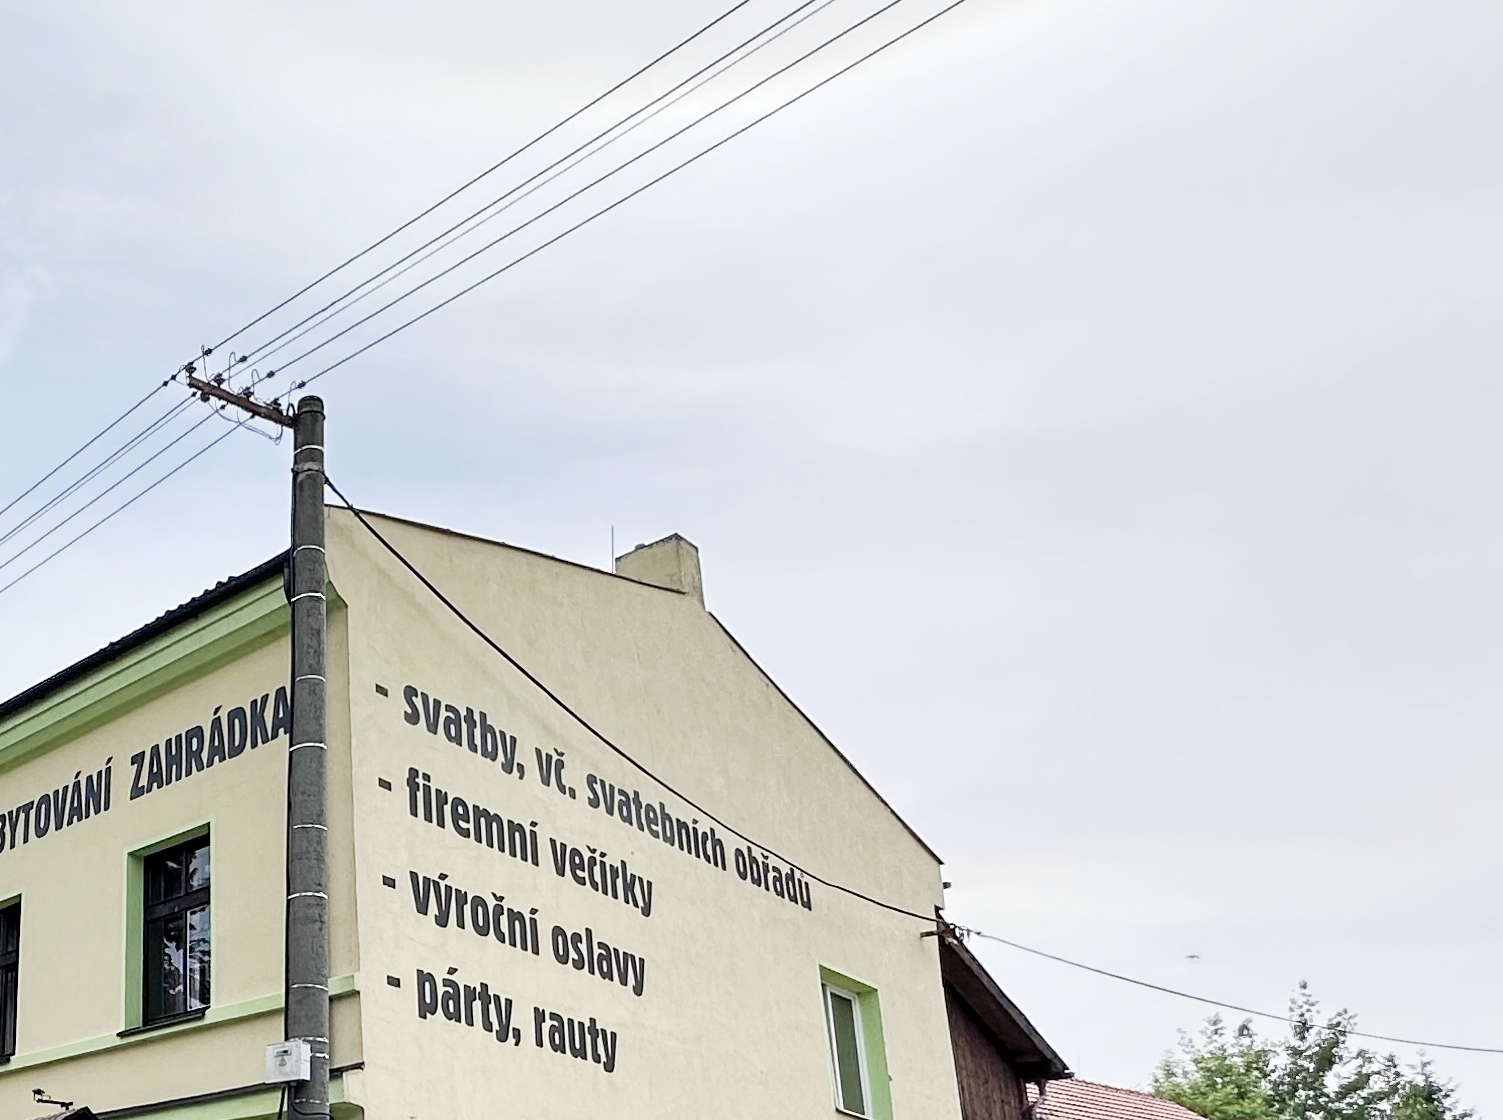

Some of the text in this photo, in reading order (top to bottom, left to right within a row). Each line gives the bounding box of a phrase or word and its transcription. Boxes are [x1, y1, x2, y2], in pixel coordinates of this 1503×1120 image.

[129, 685, 291, 800] ZAHRÁDKA
[403, 685, 525, 780] svatby,
[534, 746, 577, 799] vč.
[586, 771, 727, 872] svatebních
[734, 846, 812, 912] obřadů
[406, 767, 539, 867] firemní
[549, 837, 653, 918] večírky
[409, 870, 539, 956] výroční
[551, 925, 645, 997] oslavy
[416, 966, 521, 1047] párty,
[533, 1005, 617, 1073] rauty
